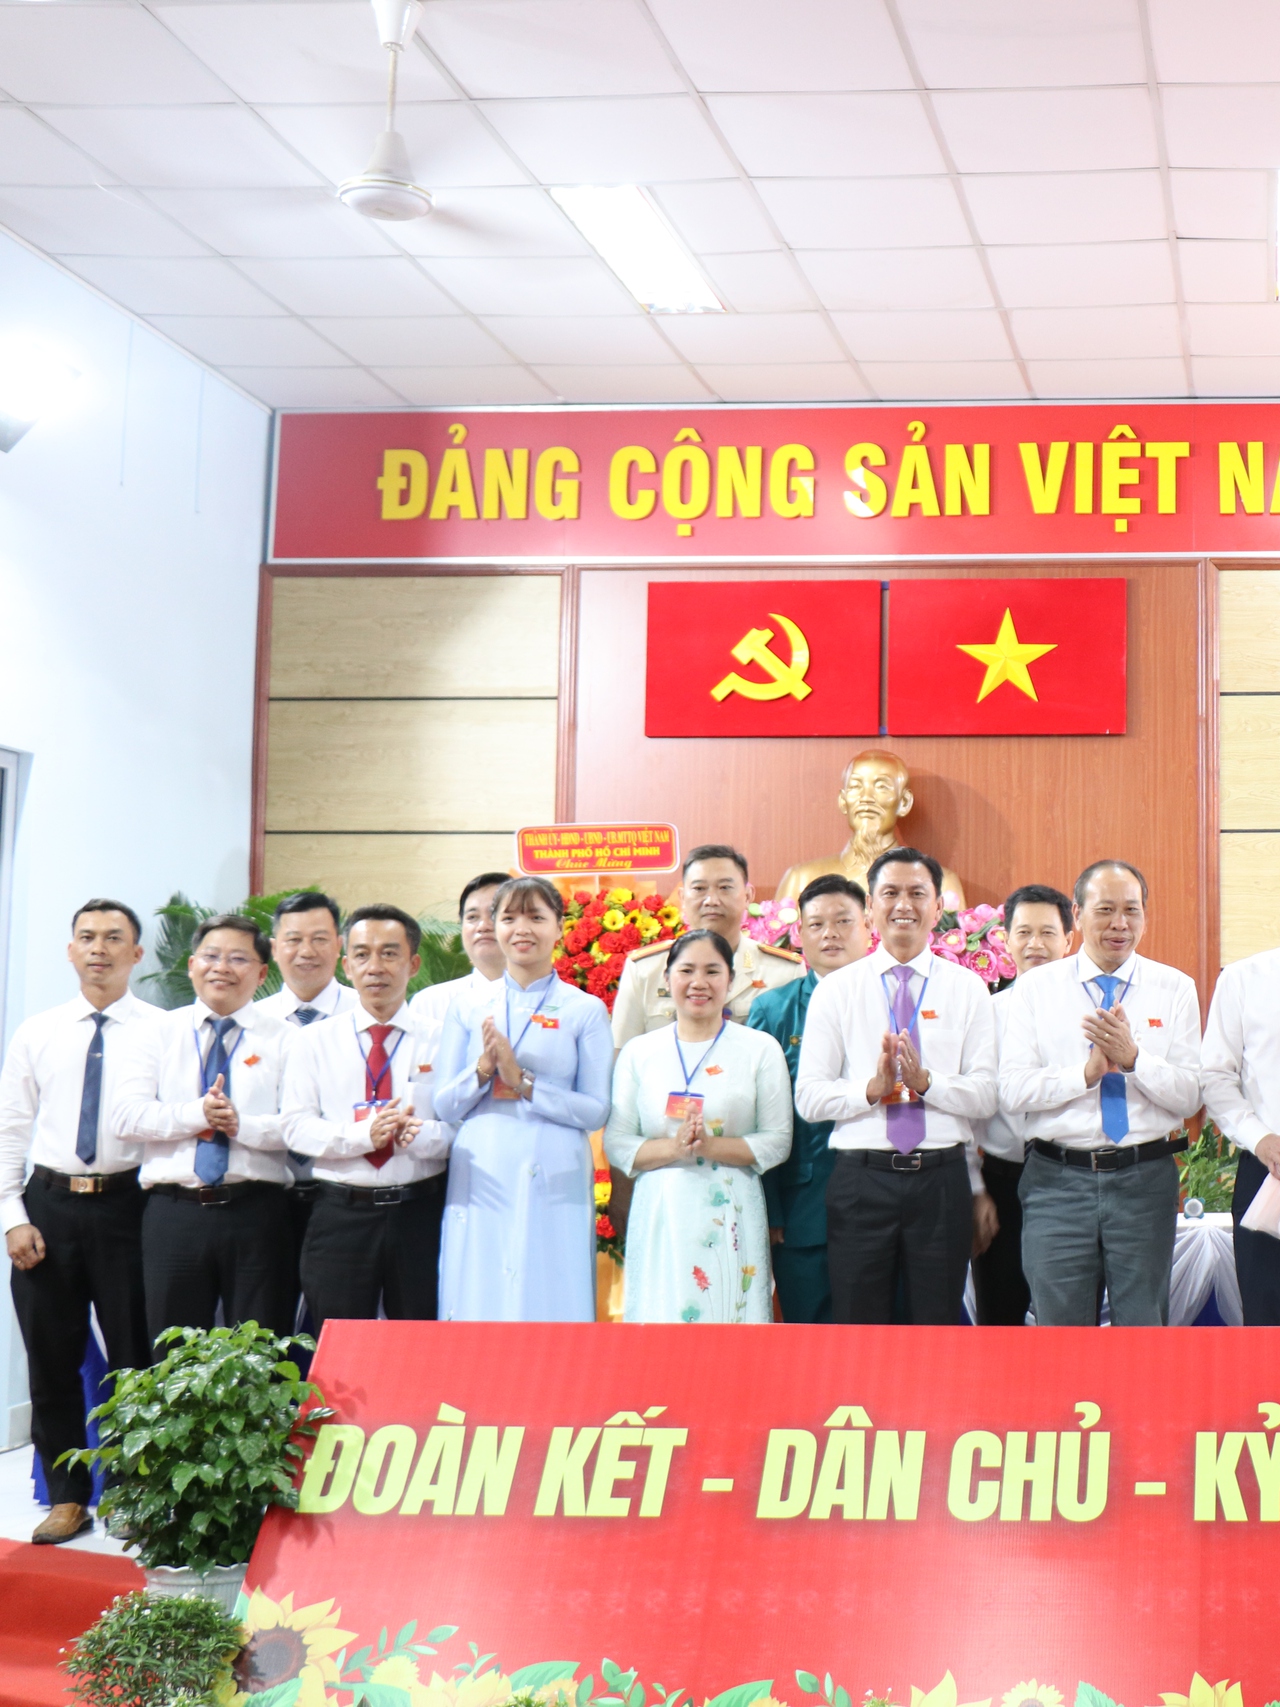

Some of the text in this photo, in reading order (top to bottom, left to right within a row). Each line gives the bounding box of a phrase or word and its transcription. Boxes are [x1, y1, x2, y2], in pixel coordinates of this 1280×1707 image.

[377, 423, 580, 521] ĐẢNG
[608, 427, 816, 538] CỘNG
[843, 420, 990, 520] SẢN
[1018, 425, 1190, 533] VIỆT
[533, 847, 569, 859] THÀNH
[571, 845, 593, 859] PHỐ
[613, 845, 631, 857] CHÍ
[633, 846, 660, 856] MINH
[555, 858, 589, 869] Chúc
[296, 1402, 526, 1516] ĐOÀN
[533, 1406, 689, 1517] KẾT
[756, 1405, 927, 1521] DÂN
[947, 1401, 1111, 1523] CHỦ
